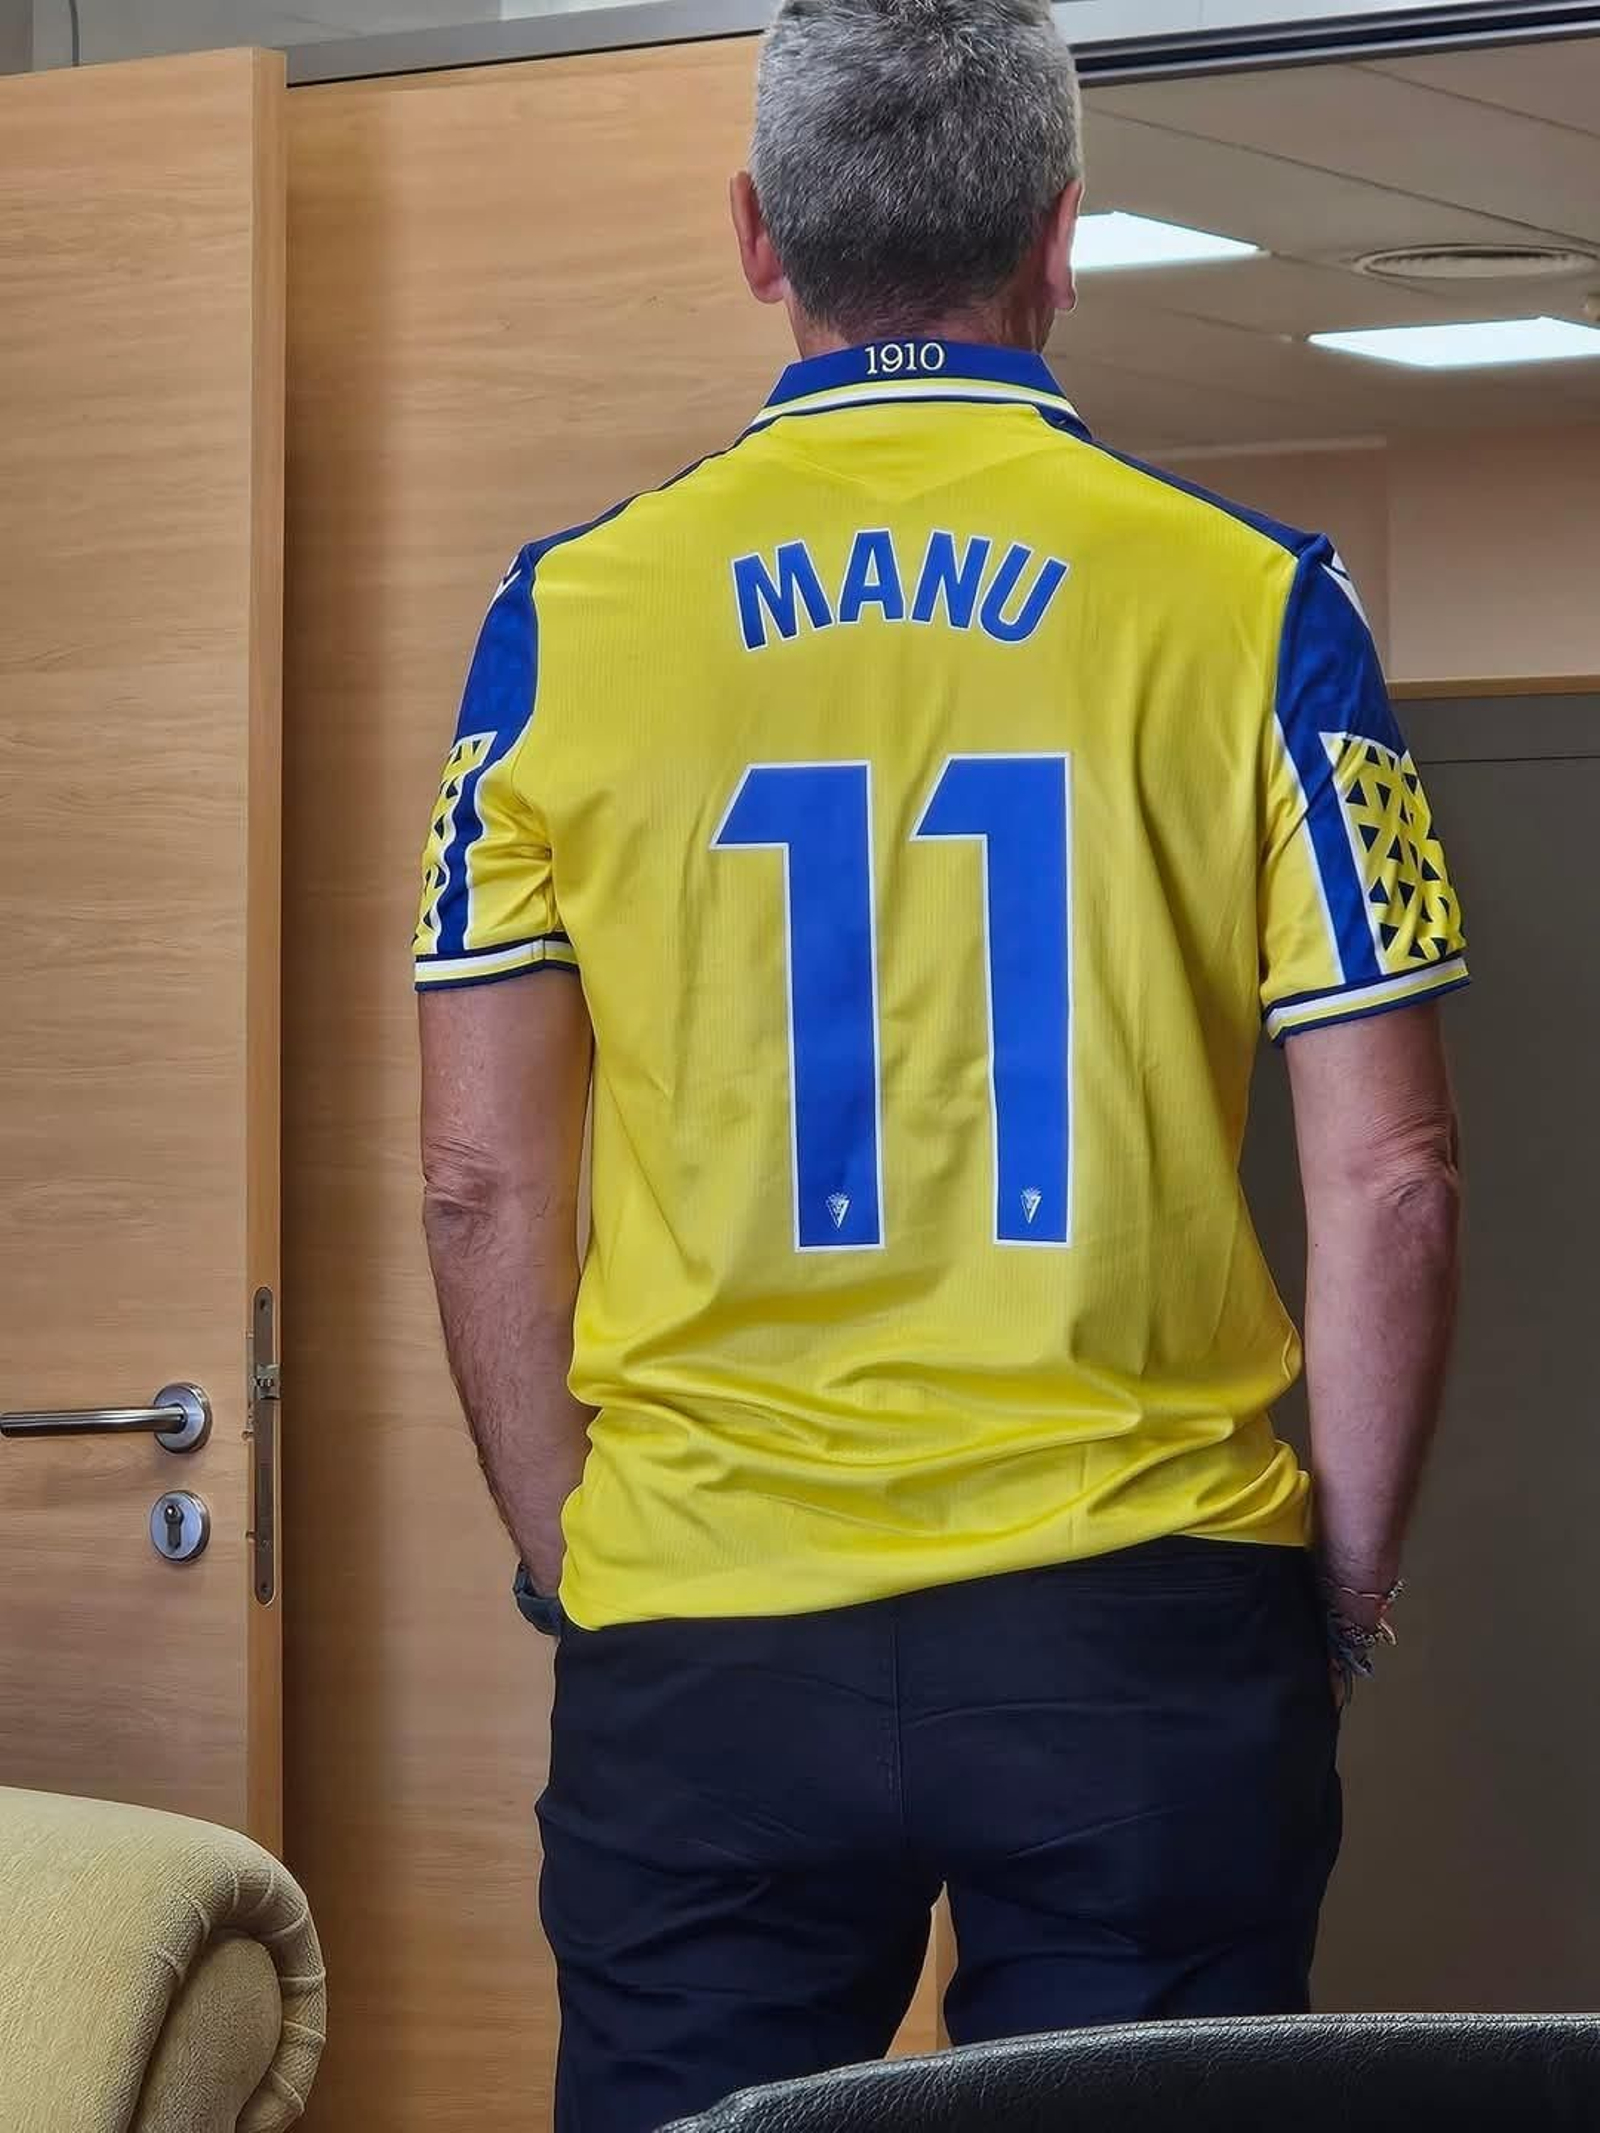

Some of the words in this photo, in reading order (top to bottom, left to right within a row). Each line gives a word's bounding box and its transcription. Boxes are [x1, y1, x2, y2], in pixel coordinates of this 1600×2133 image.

[864, 342, 945, 375] 1910
[731, 528, 1070, 651] MANU
[709, 752, 1073, 1252] 11
